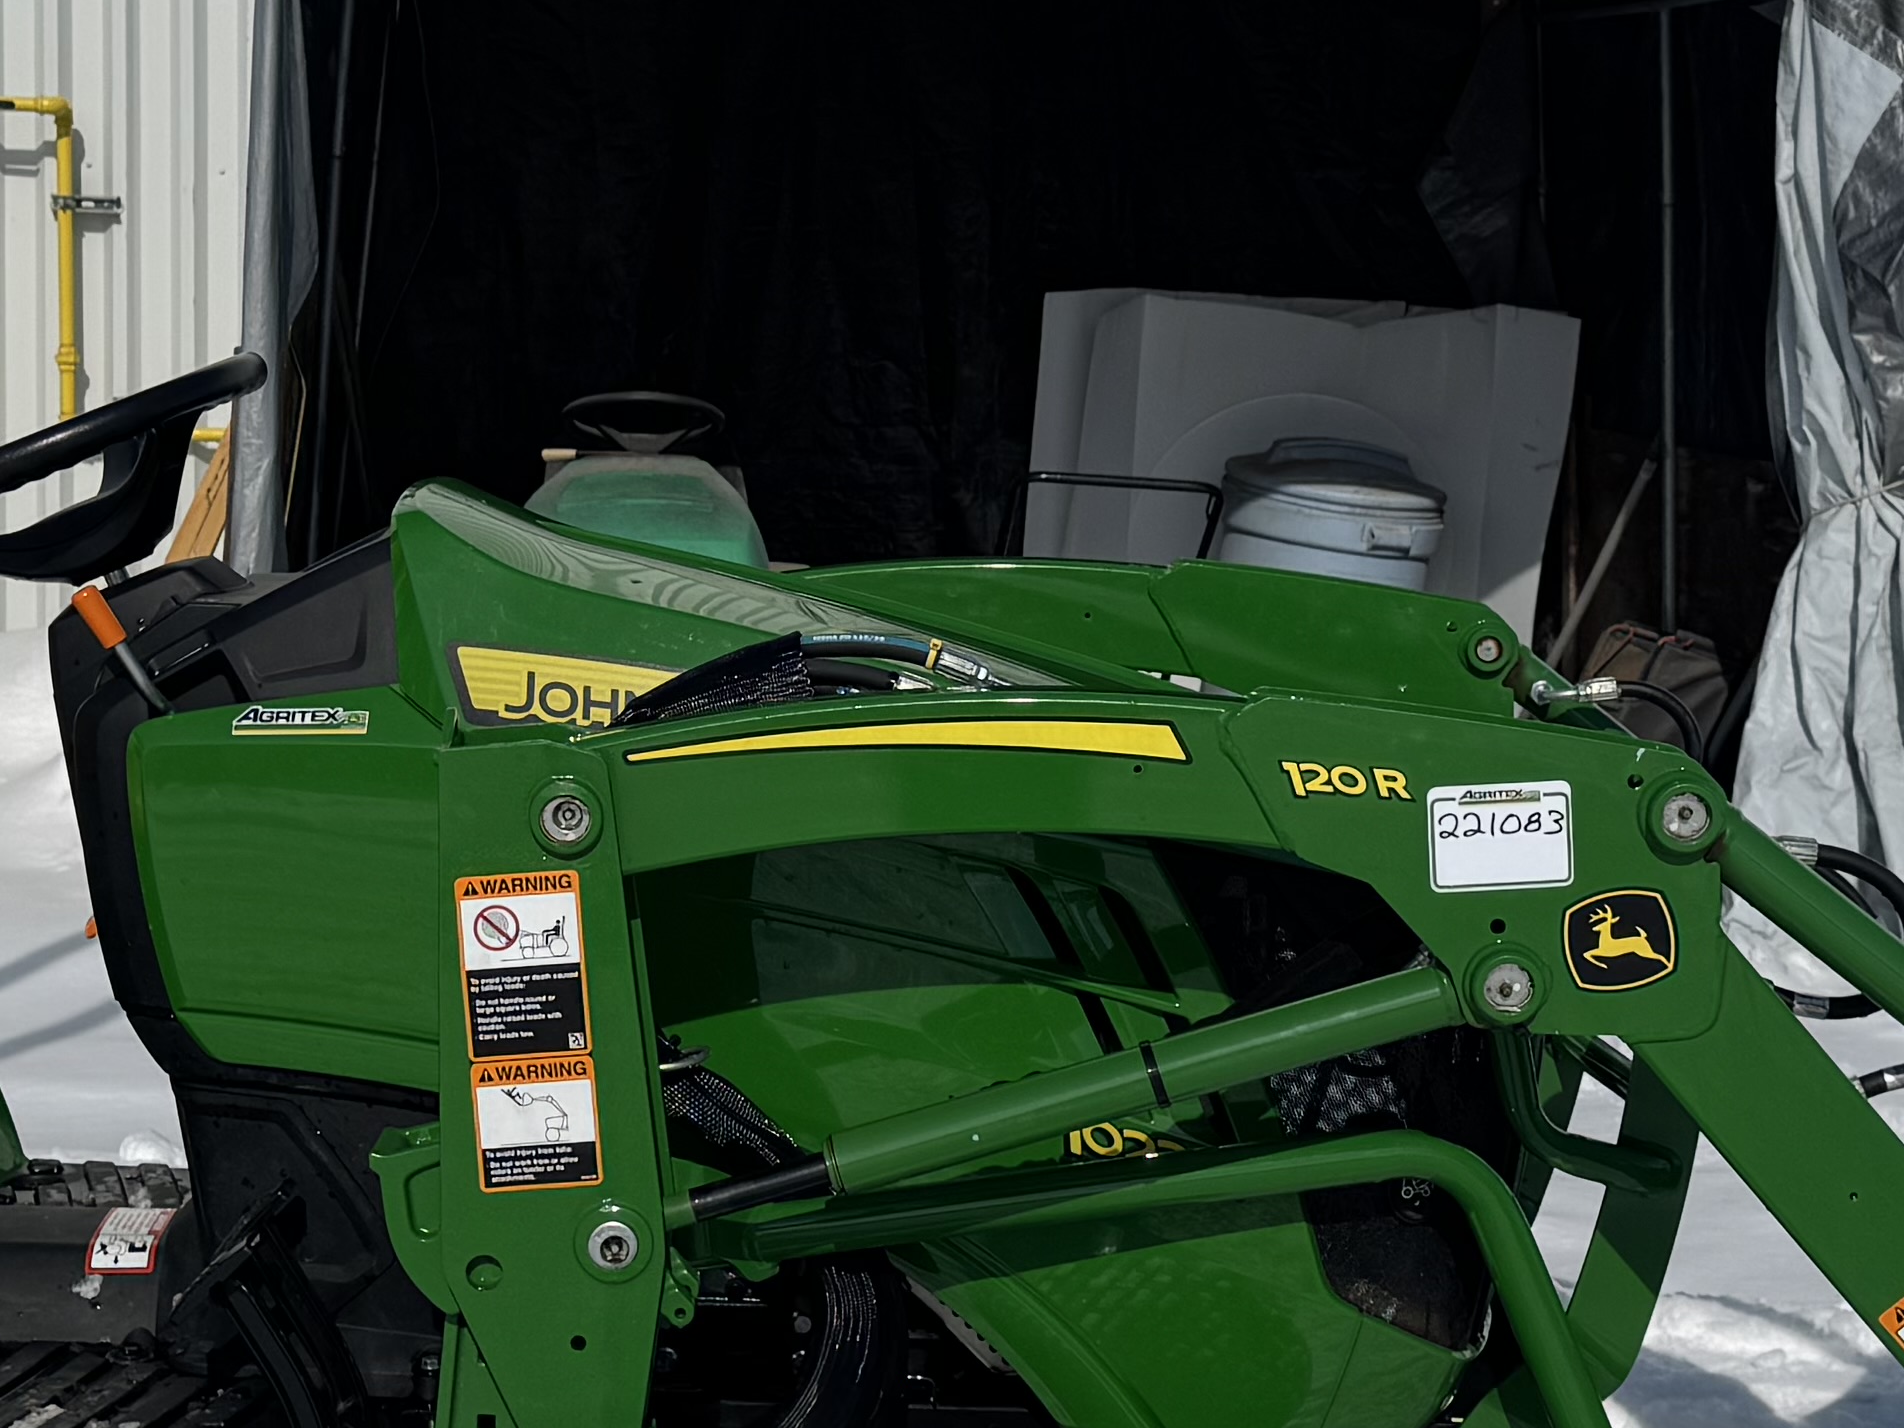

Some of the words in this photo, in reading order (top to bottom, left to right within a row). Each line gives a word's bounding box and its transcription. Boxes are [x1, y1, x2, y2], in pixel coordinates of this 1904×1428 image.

[236, 708, 342, 723] AGRITEX
[1438, 809, 1565, 839] 221083
[480, 873, 572, 895] WARNING
[495, 1060, 587, 1081] WARNING
